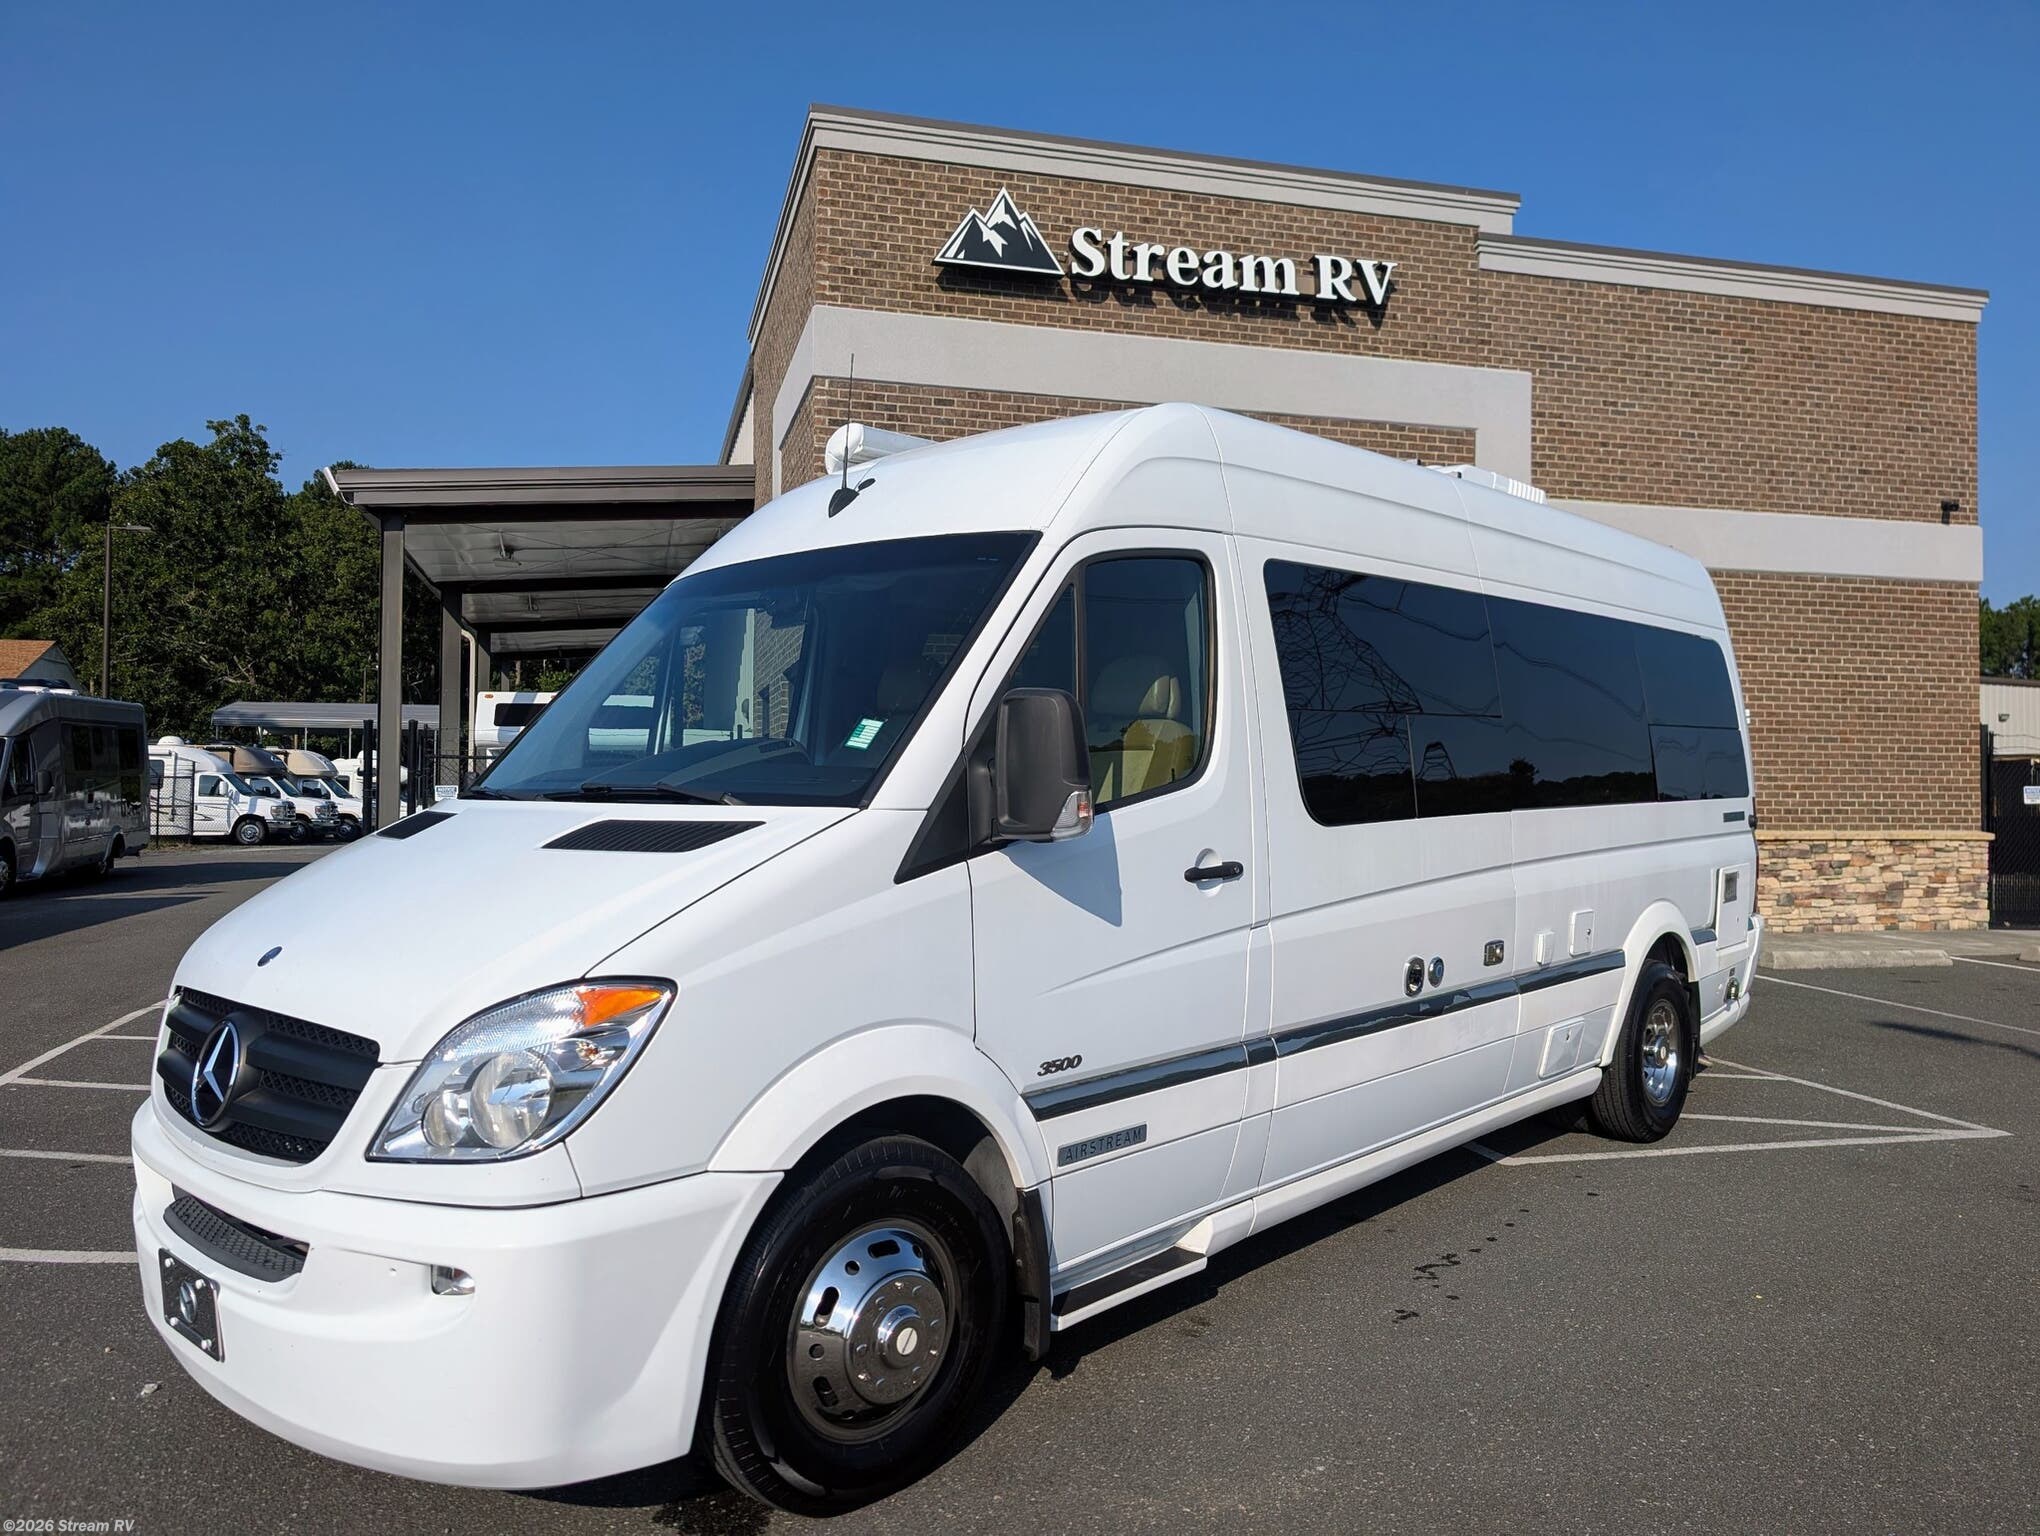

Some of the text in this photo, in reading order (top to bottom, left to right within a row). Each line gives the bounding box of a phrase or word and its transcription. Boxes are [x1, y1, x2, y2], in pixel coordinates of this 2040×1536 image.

[1071, 226, 1398, 305] Stream RV
[1037, 1054, 1083, 1077] 3500
[1065, 1129, 1142, 1161] AIRSTREAM
